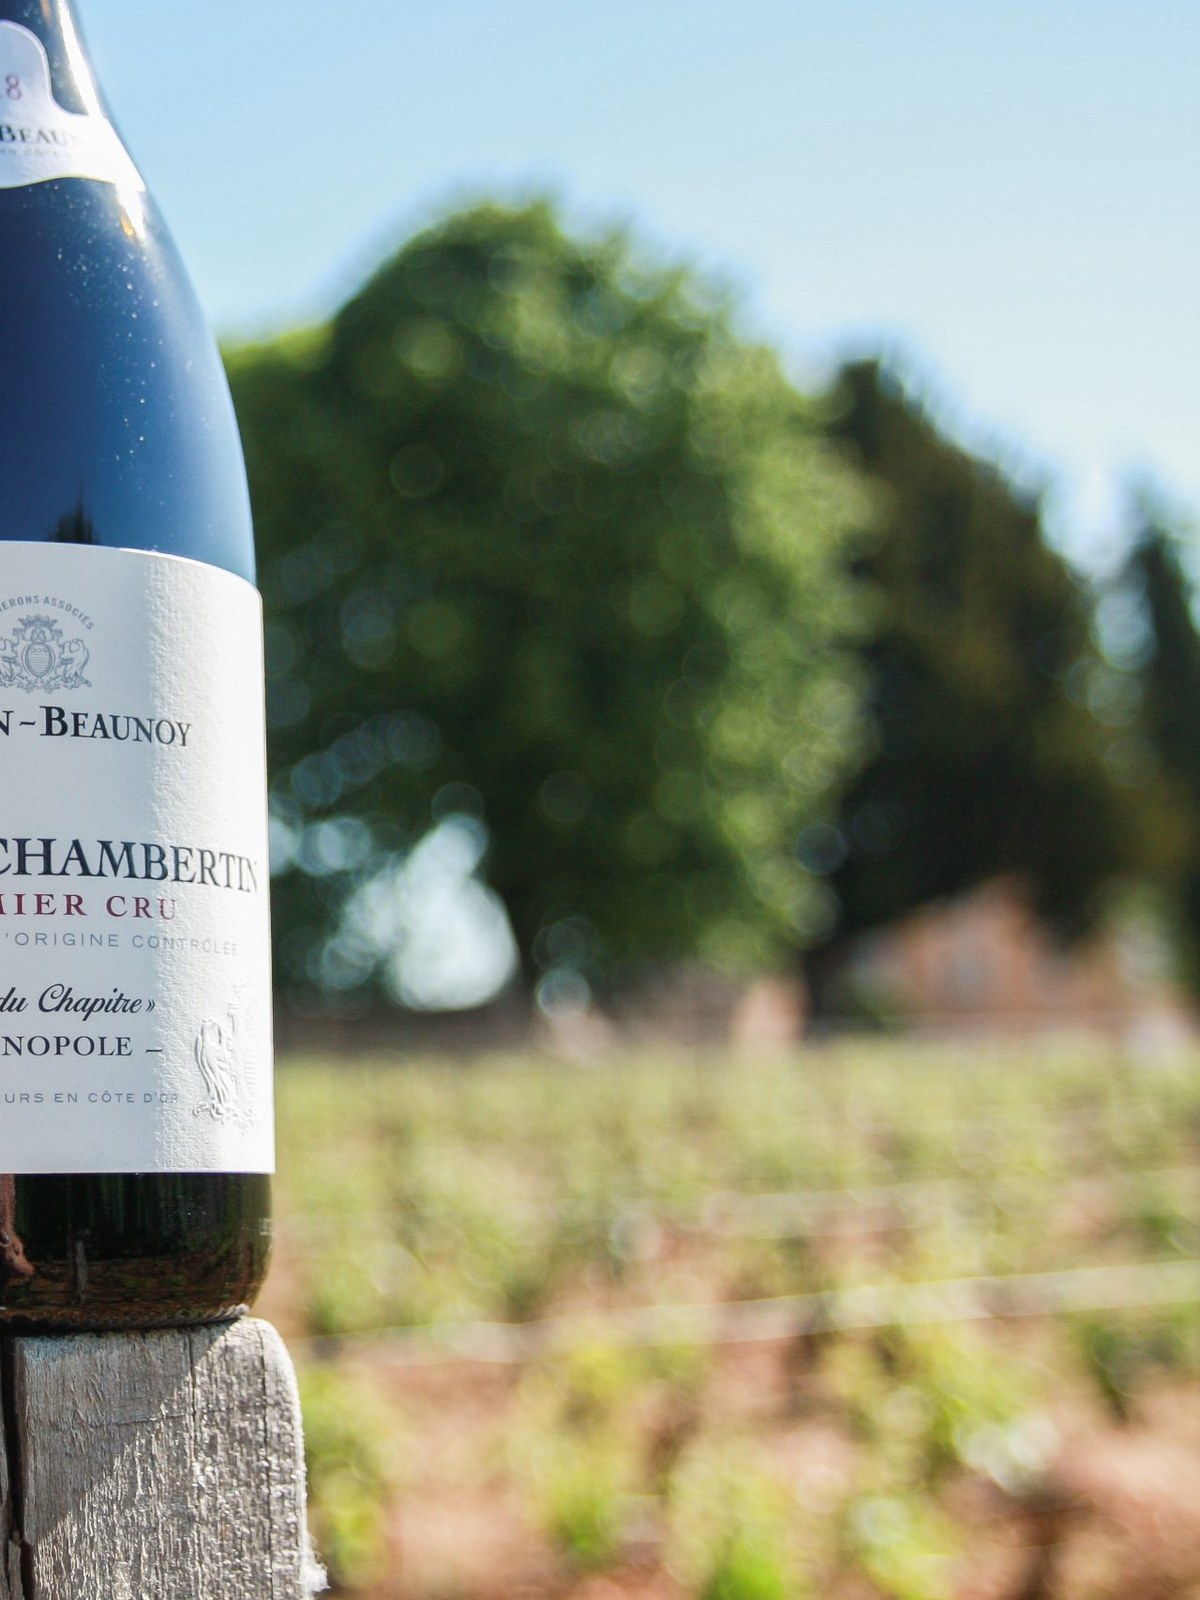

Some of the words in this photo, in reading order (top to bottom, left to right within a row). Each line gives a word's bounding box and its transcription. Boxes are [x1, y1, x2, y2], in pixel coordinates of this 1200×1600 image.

[106, 895, 177, 921] CRU
[54, 1093, 78, 1103] EN
[88, 1090, 135, 1103] CÔTE
[143, 1092, 179, 1103] D'OR
